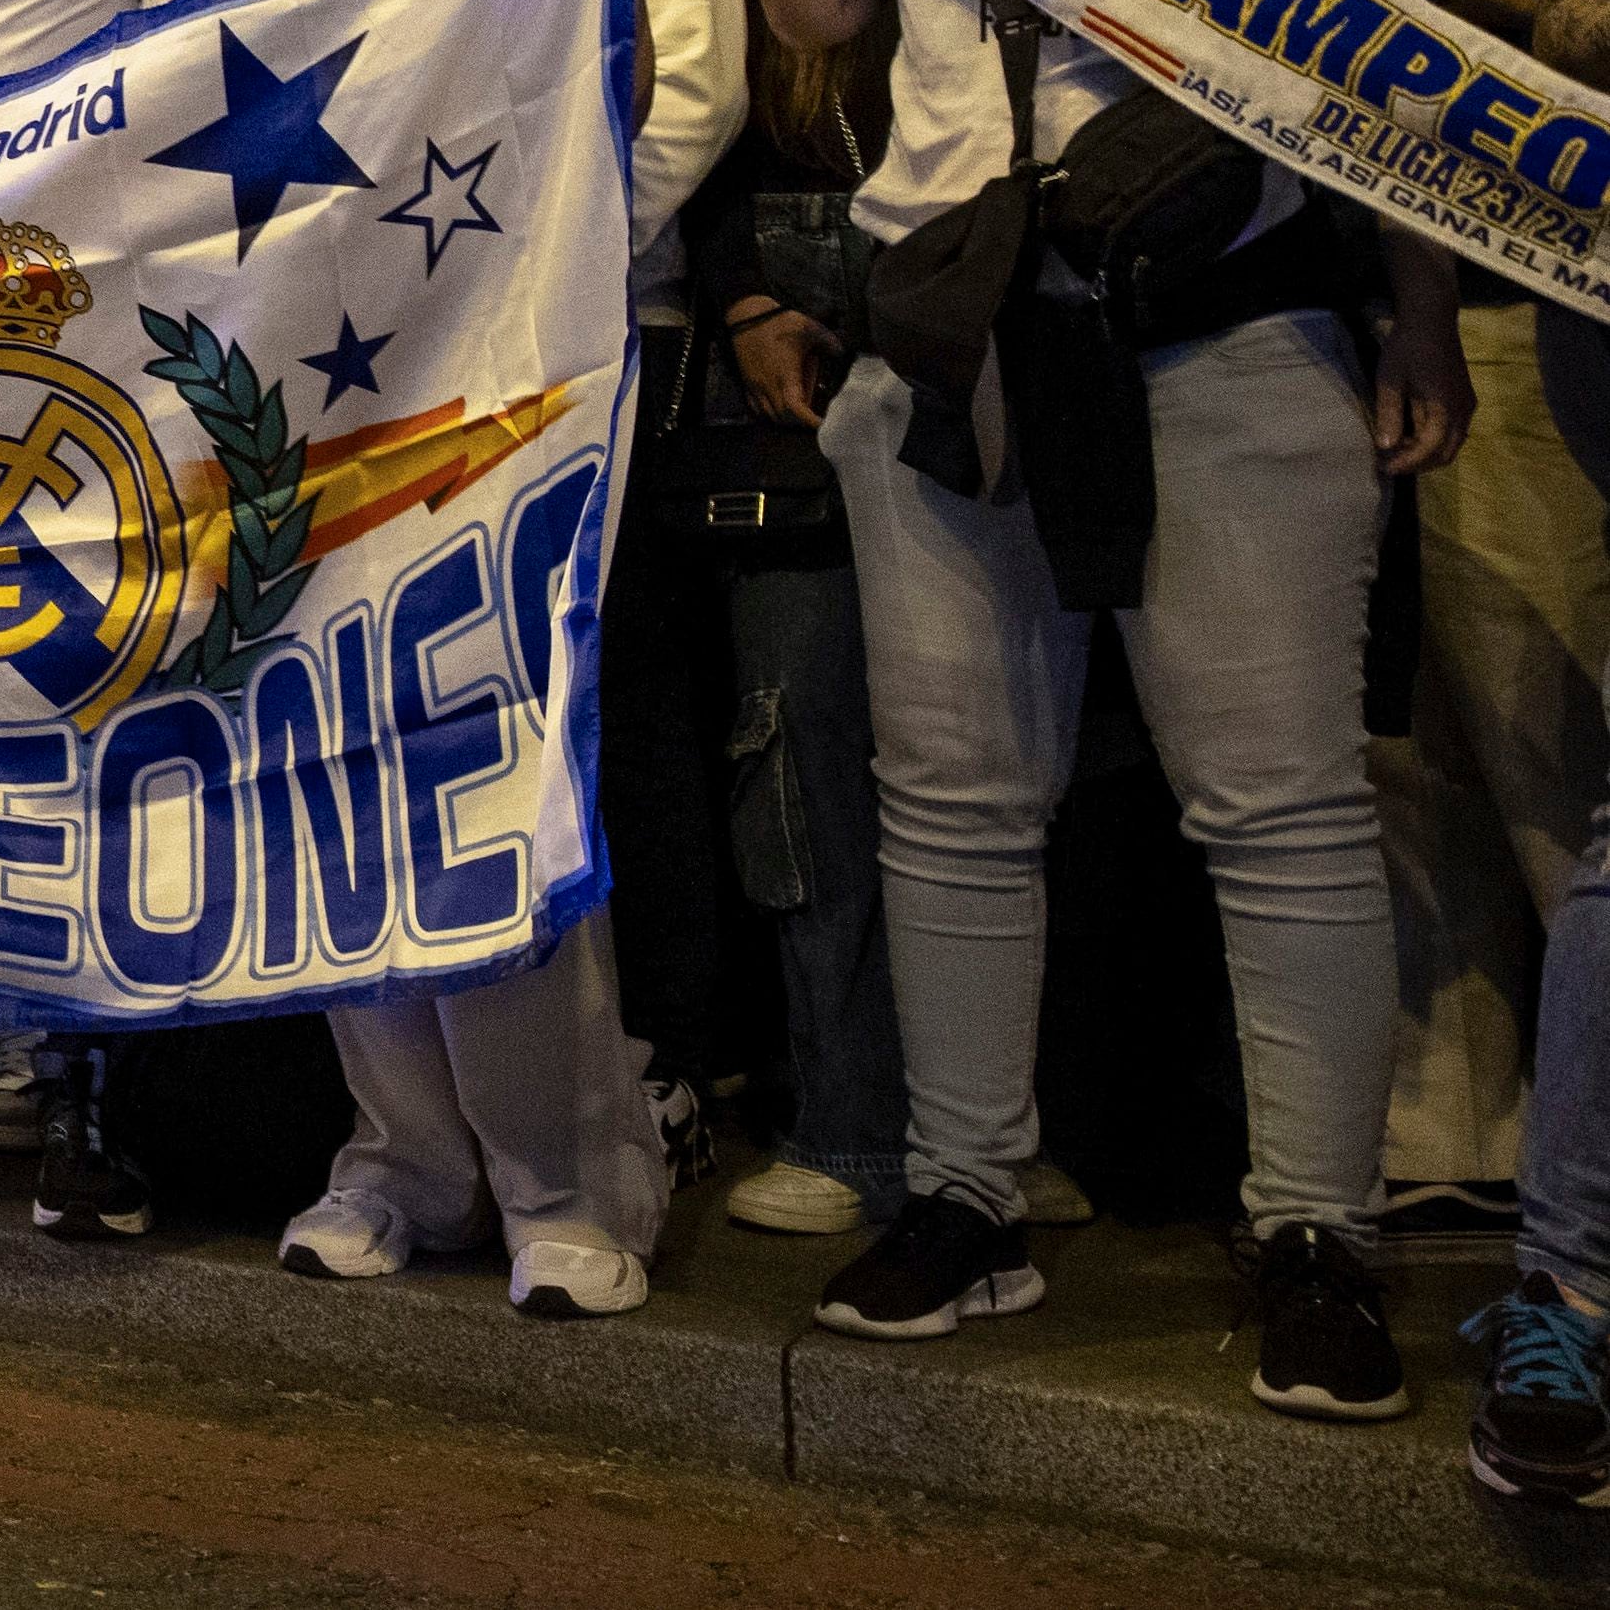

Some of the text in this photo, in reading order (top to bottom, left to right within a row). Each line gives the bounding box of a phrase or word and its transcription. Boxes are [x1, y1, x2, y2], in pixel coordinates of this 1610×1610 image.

[1312, 99, 1592, 257] DE LIGA 23/24
[1388, 188, 1491, 247] GANA
[1501, 243, 1542, 273] EL
